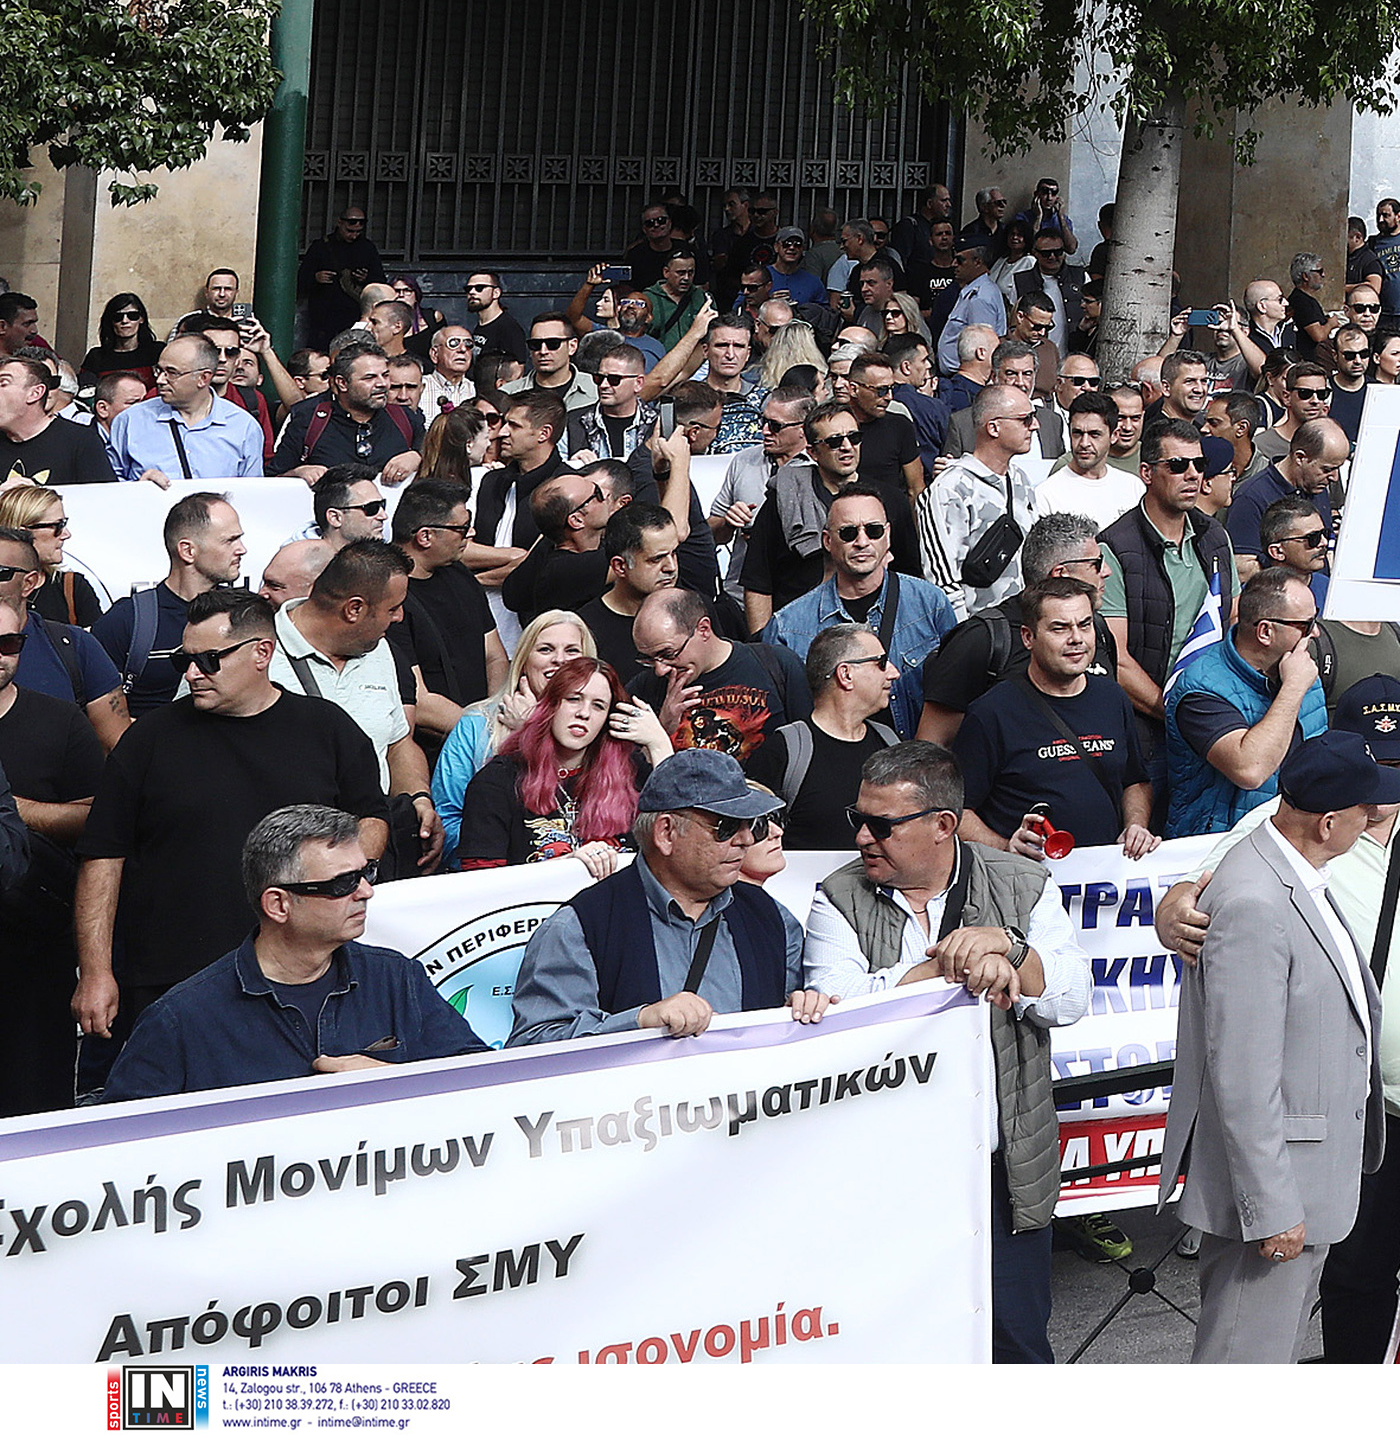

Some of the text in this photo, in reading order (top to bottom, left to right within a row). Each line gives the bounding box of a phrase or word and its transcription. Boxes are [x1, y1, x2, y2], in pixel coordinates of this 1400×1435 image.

[446, 917, 548, 963] ΠΕΡΙΦΕΡ
[0, 1048, 938, 1258] χολής Μονίμων Υπαξιωματικών
[95, 1234, 586, 1362] Απόφοιτοι ΣΜΥ
